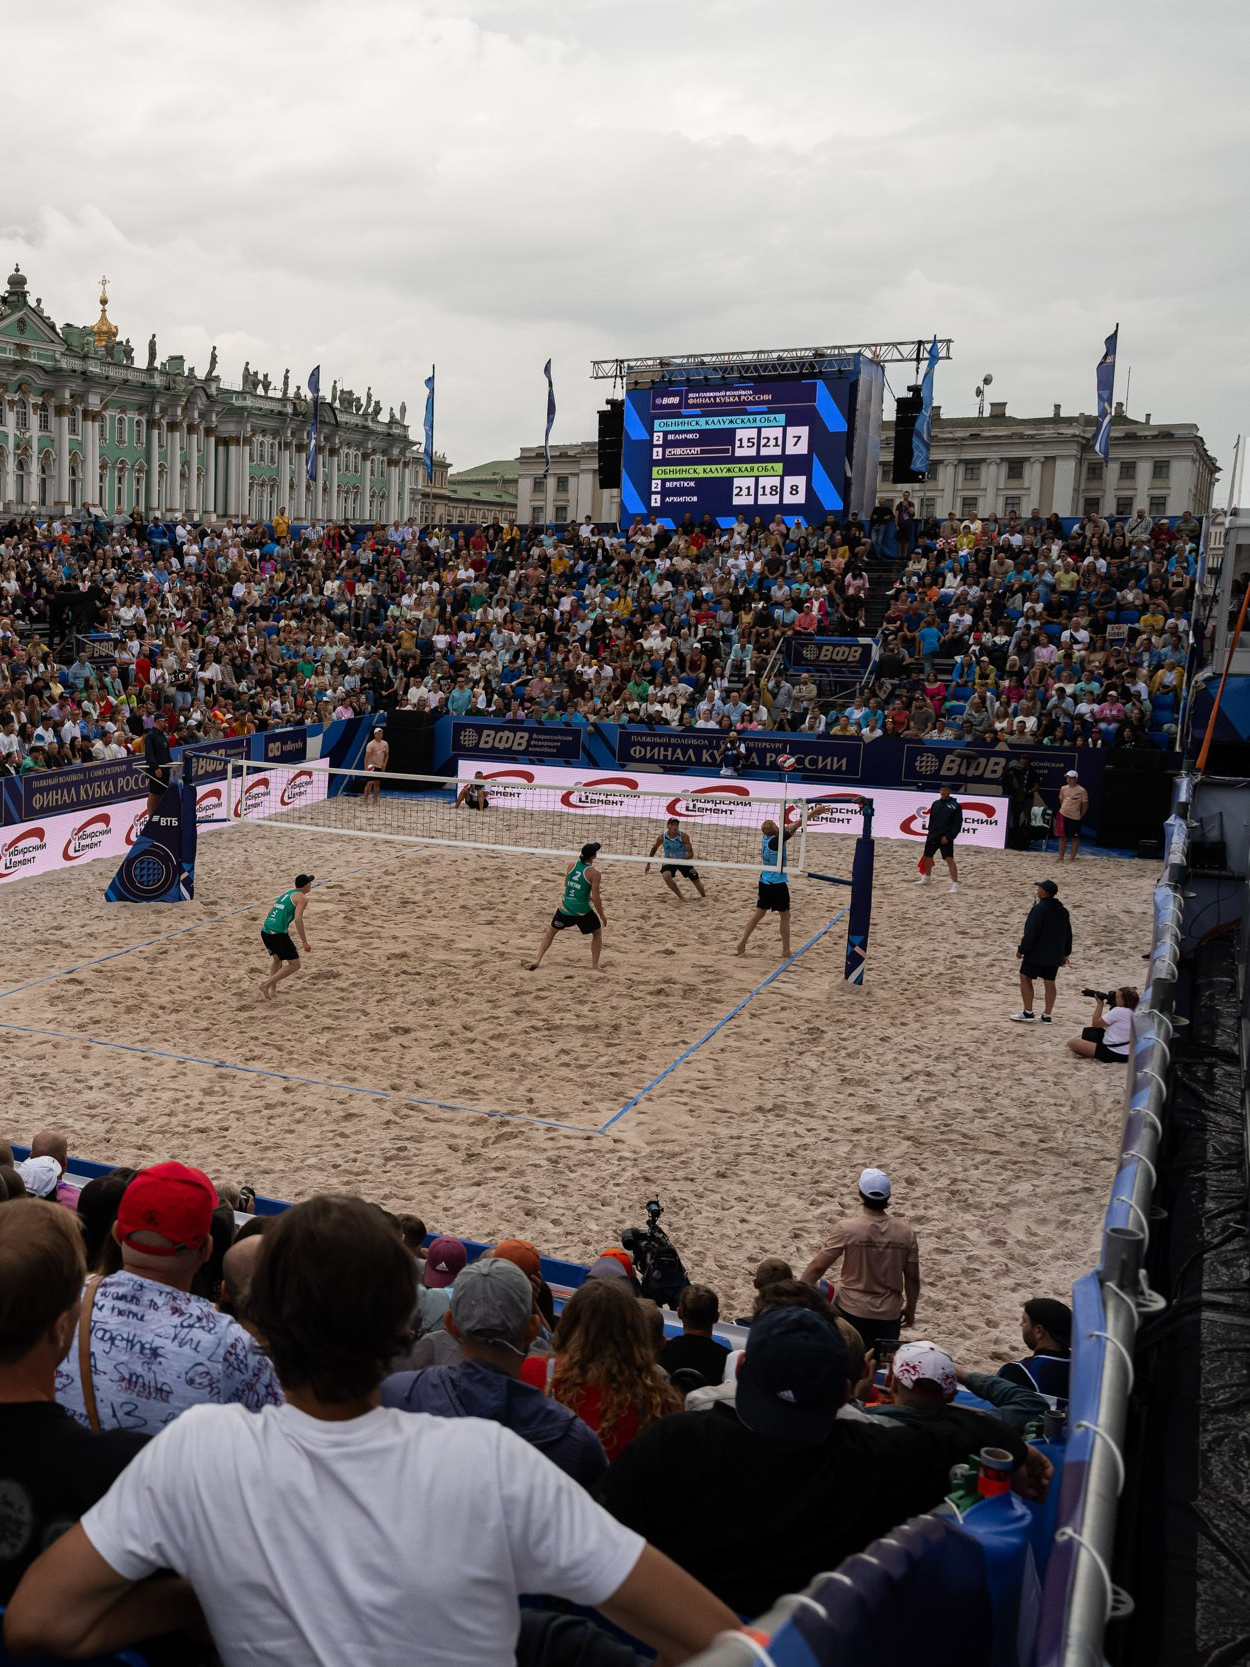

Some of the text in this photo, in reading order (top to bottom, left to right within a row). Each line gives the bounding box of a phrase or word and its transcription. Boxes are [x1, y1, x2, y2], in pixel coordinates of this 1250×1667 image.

[740, 394, 772, 402] РОССИИ
[658, 416, 780, 428] ОБНИНСК, КАЛУЖСКАЯ ОБЛ.
[737, 437, 756, 448] 15
[762, 436, 781, 448] 21
[792, 435, 802, 447] 7
[656, 465, 778, 476] ОБНИНСК, КАЛУЖСКАЯ ОБЛ.
[734, 486, 753, 497] 21
[759, 485, 779, 496] 18
[789, 484, 799, 496] 8
[819, 646, 862, 662] ВФВ
[478, 730, 530, 750] ВФВ
[631, 735, 670, 744] ПЛЯЖНЫЙ
[670, 736, 709, 746] ВОЛЕЙБОЛ
[630, 746, 847, 771] ФИНАЛ КУА РССИИ
[940, 754, 1007, 778] ВФВ
[32, 787, 77, 810] ФИНАЛ
[80, 780, 114, 800] КУБКА
[490, 790, 522, 798] емент
[578, 794, 624, 806] Цемент
[685, 802, 734, 815] Цемент
[160, 817, 178, 827] ВТБ
[810, 816, 852, 824] емент
[71, 826, 112, 842] Сибирский
[1, 842, 46, 858] Сибирский
[74, 840, 102, 854] Цемент
[4, 855, 36, 870] Цемент
[572, 870, 582, 880] 2
